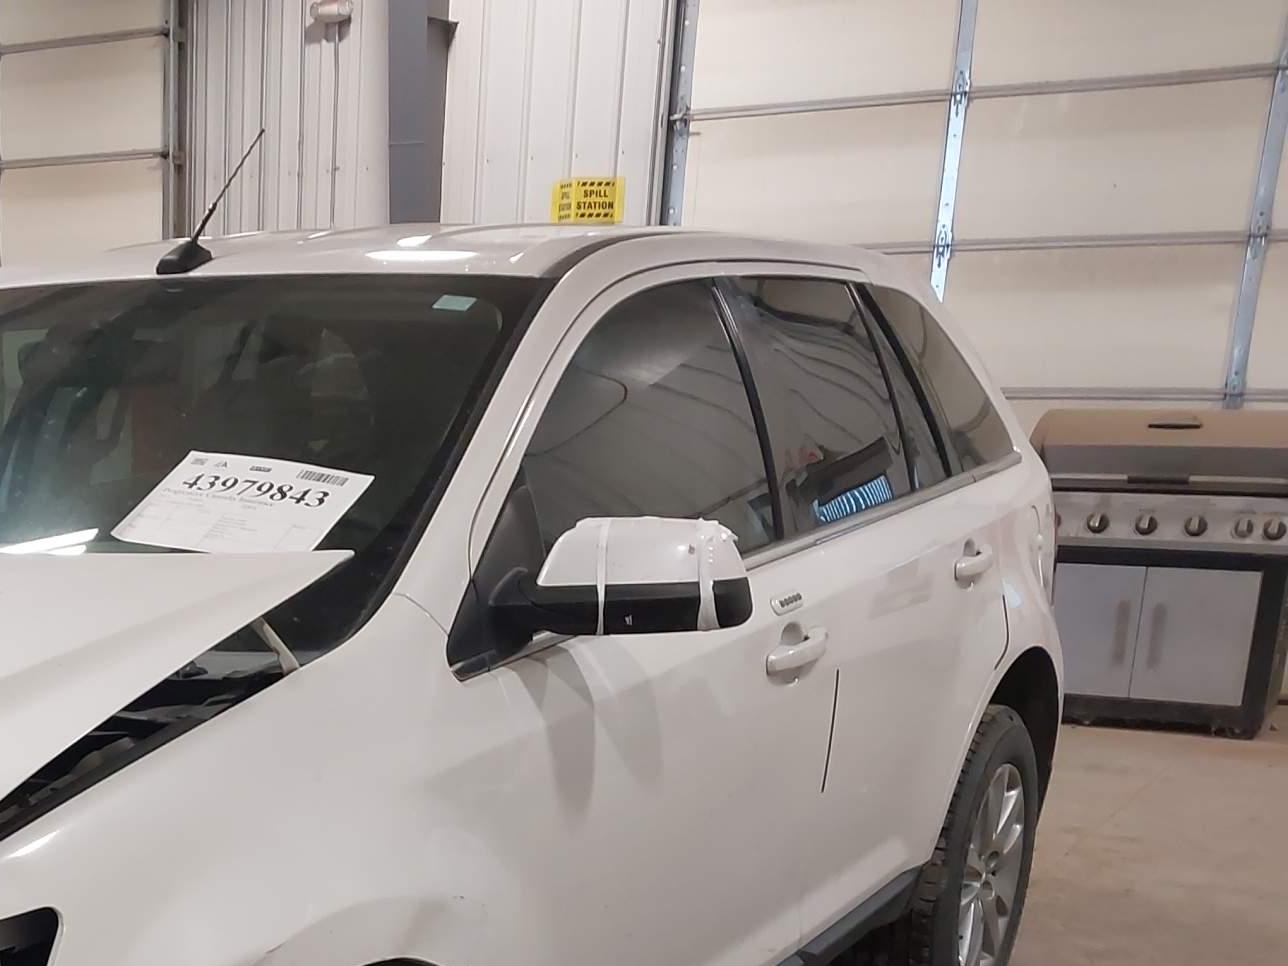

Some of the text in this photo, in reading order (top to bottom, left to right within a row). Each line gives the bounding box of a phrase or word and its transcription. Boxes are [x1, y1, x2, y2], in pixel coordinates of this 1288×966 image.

[583, 189, 609, 198] SPILL
[576, 201, 614, 210] STATION
[182, 472, 331, 508] 43979843
